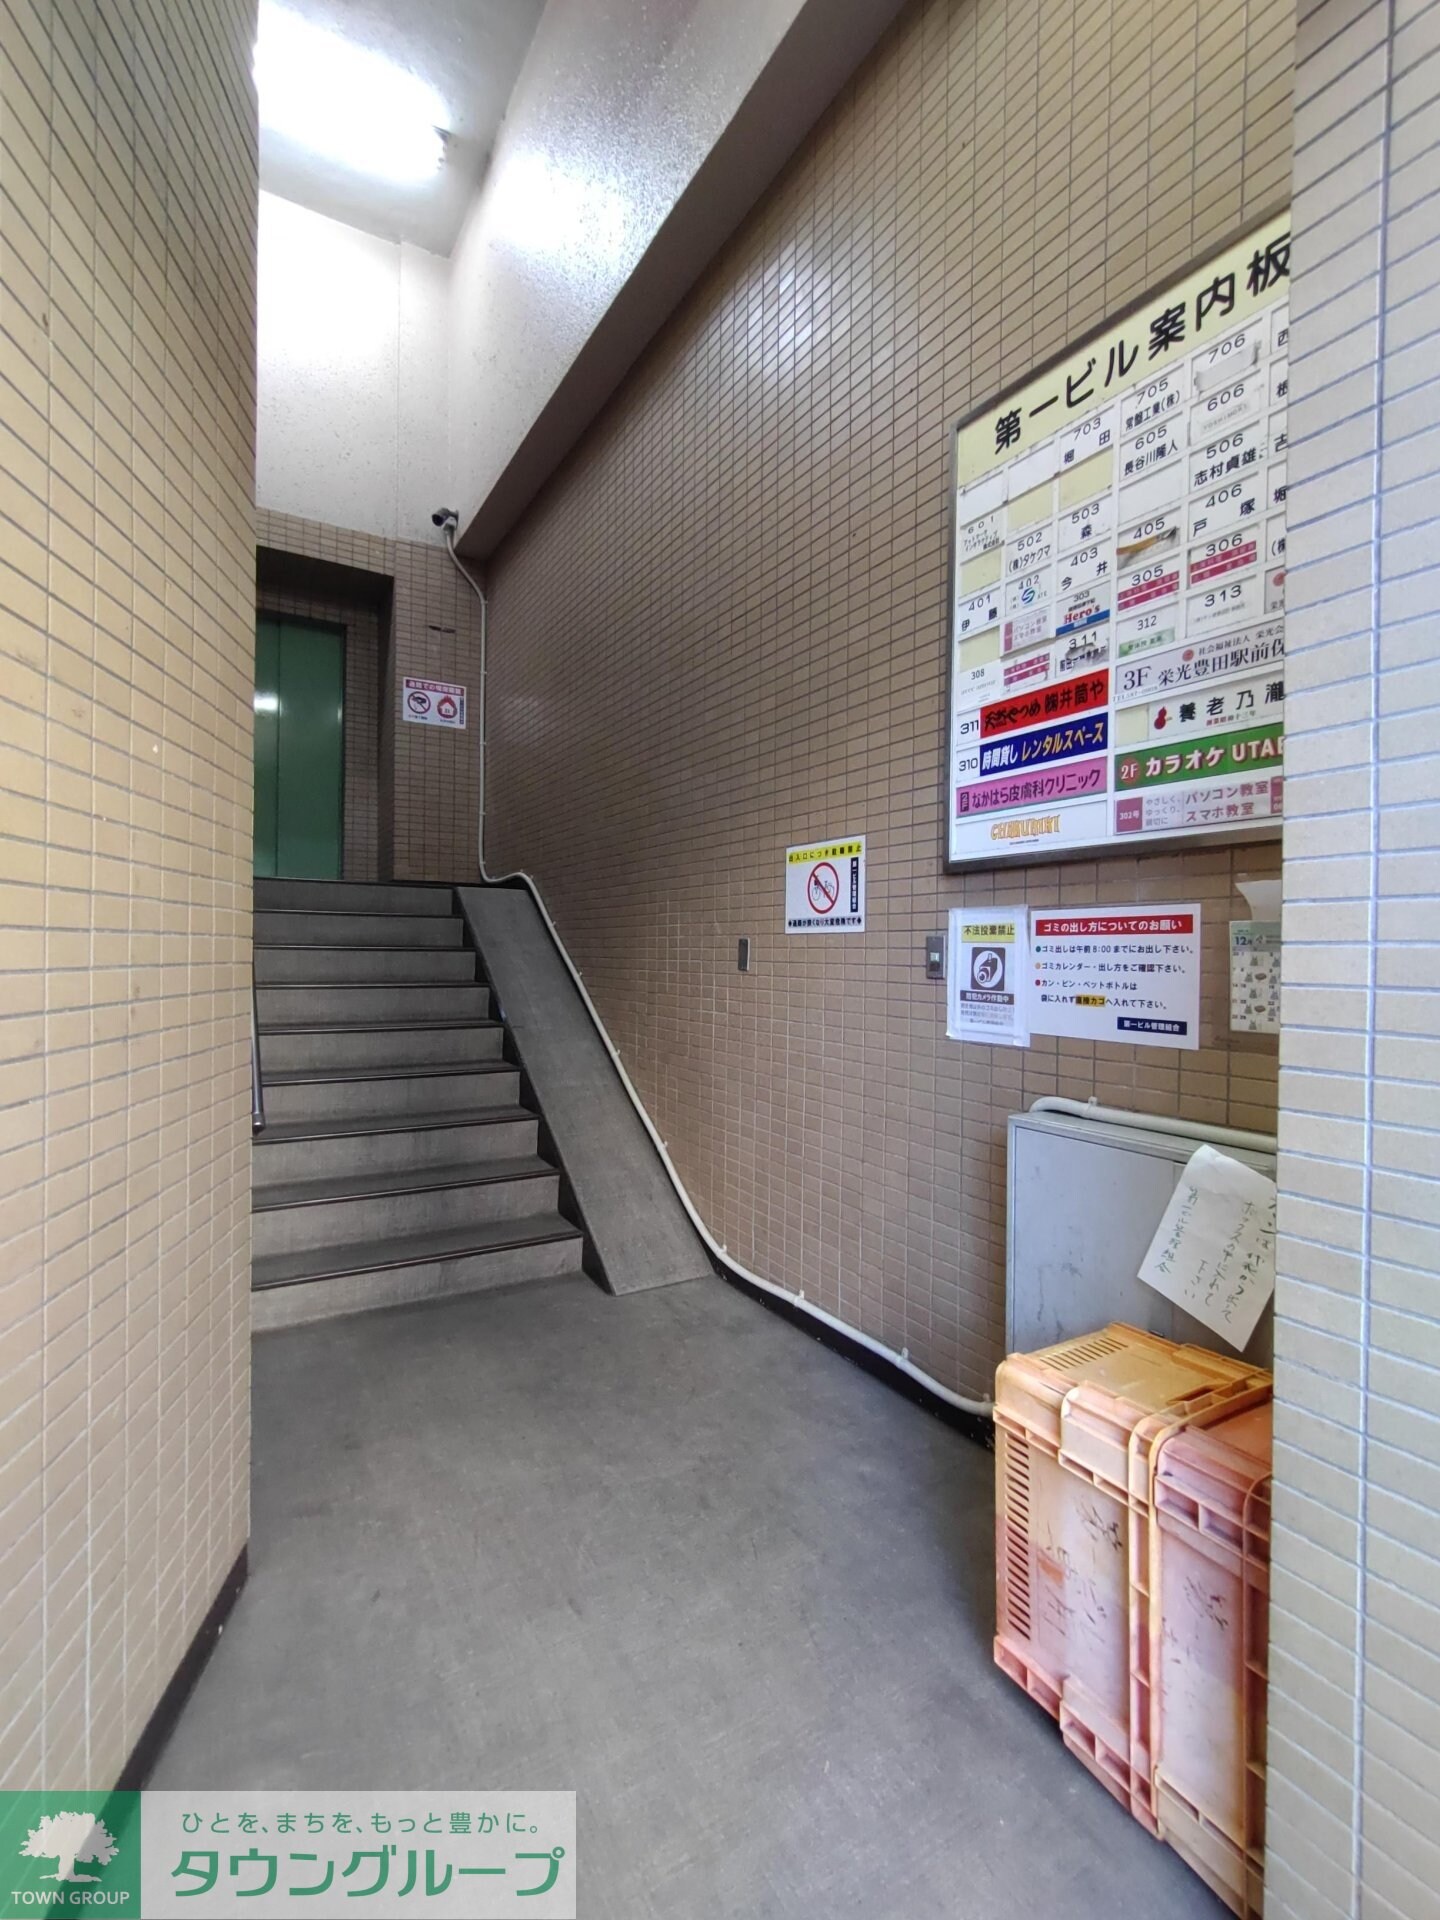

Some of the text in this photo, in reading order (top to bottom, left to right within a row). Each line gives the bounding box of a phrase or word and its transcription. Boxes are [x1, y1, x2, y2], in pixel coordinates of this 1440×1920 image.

[994, 231, 1290, 455] 第一ビル案内板
[1208, 333, 1246, 365] 706
[1136, 377, 1169, 406] 705
[1207, 383, 1245, 411] 606
[1073, 417, 1101, 441] 703
[1134, 424, 1168, 450] 605
[1206, 433, 1244, 460] 506
[1205, 483, 1243, 509] 406
[1071, 503, 1100, 524] 503
[1133, 517, 1166, 540] 405
[1017, 531, 1043, 551] 502
[1205, 533, 1243, 557] 306
[1070, 547, 1099, 567] 403
[1018, 574, 1040, 590] 402
[1131, 564, 1164, 586] 305
[968, 594, 991, 612] 401
[1204, 584, 1242, 608] 313
[1064, 604, 1100, 624] Hero's
[1137, 615, 1157, 631] 312
[1069, 631, 1097, 649] 311
[971, 668, 985, 681] 308
[1123, 665, 1152, 691] 3F
[960, 719, 979, 735] 311
[959, 722, 1104, 772] 310 時間貸し レンタルスペース
[1120, 763, 1138, 780] 2F
[1145, 746, 1225, 778] カラオケ
[972, 769, 1101, 809] なかはら皮膚科クリニック
[1185, 780, 1269, 805] パソコン教室
[1186, 802, 1255, 823] スマホ教室
[1043, 919, 1183, 933] ゴミの出し方についてのお願い
